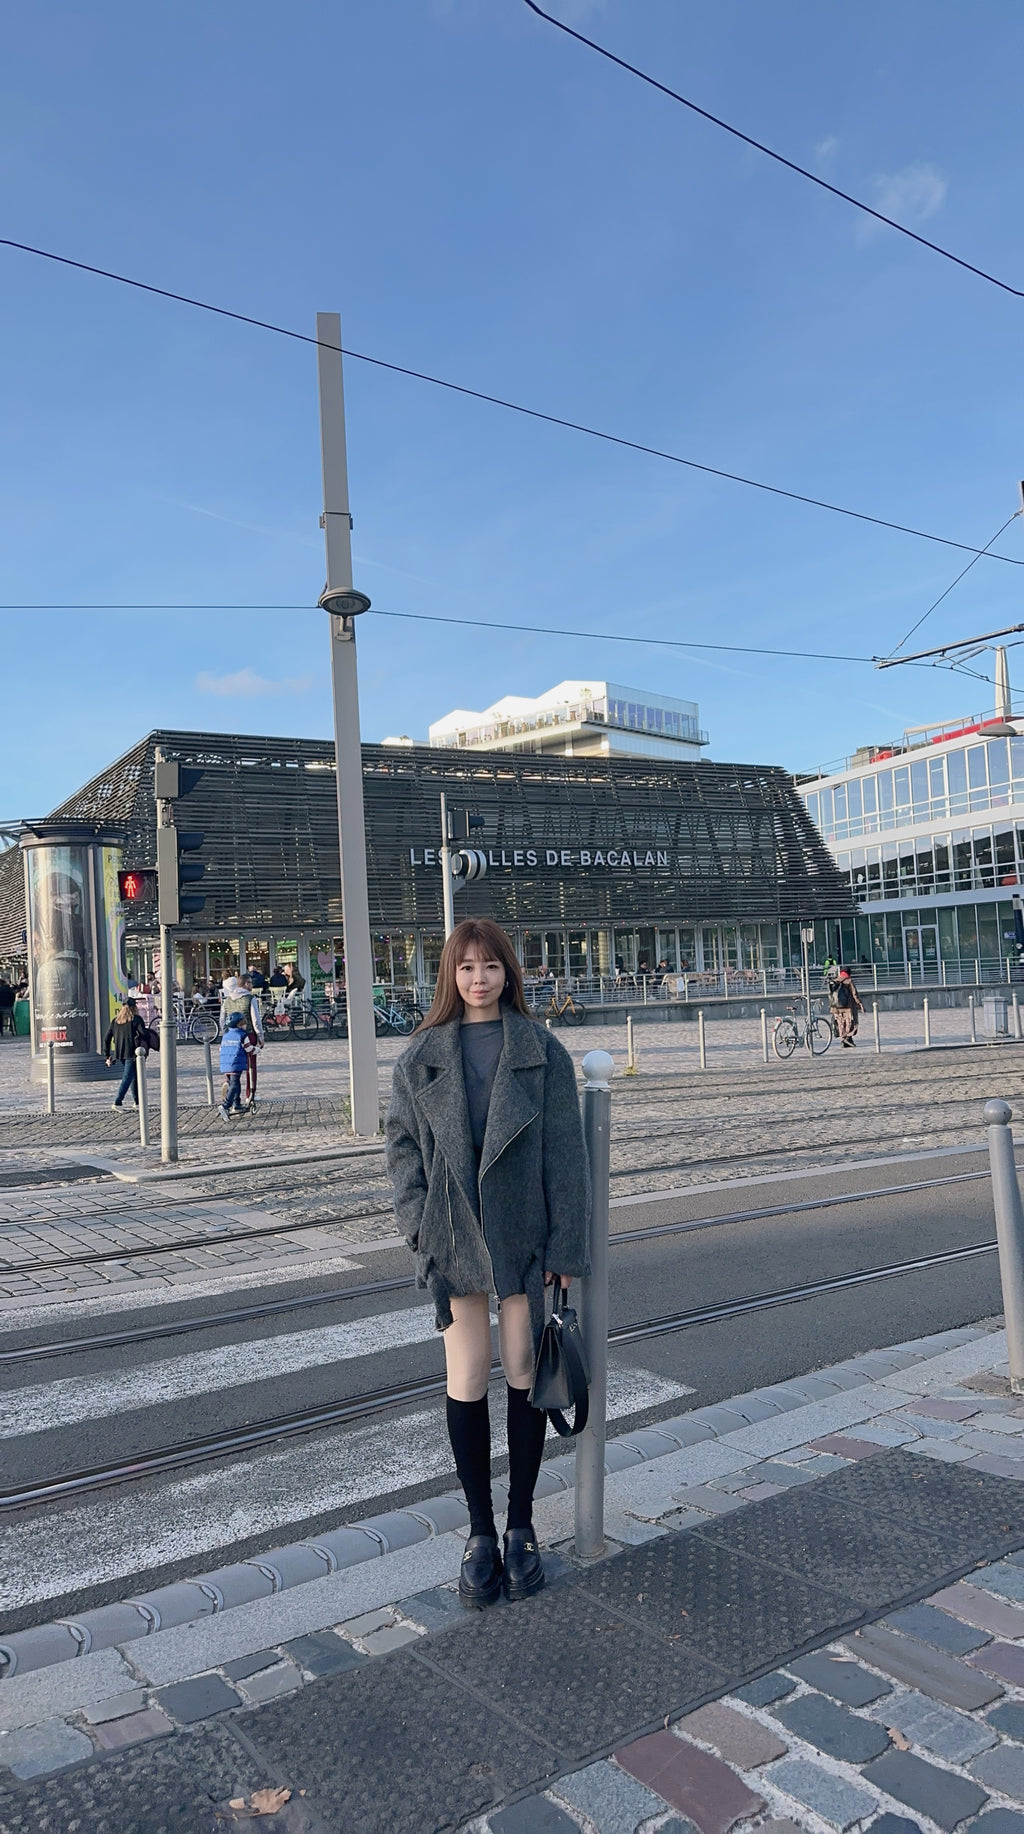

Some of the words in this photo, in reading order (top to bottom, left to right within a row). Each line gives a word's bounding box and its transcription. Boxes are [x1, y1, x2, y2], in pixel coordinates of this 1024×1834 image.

[462, 850, 538, 866] LLES
[546, 850, 572, 866] DE
[580, 850, 669, 867] BACALAN
